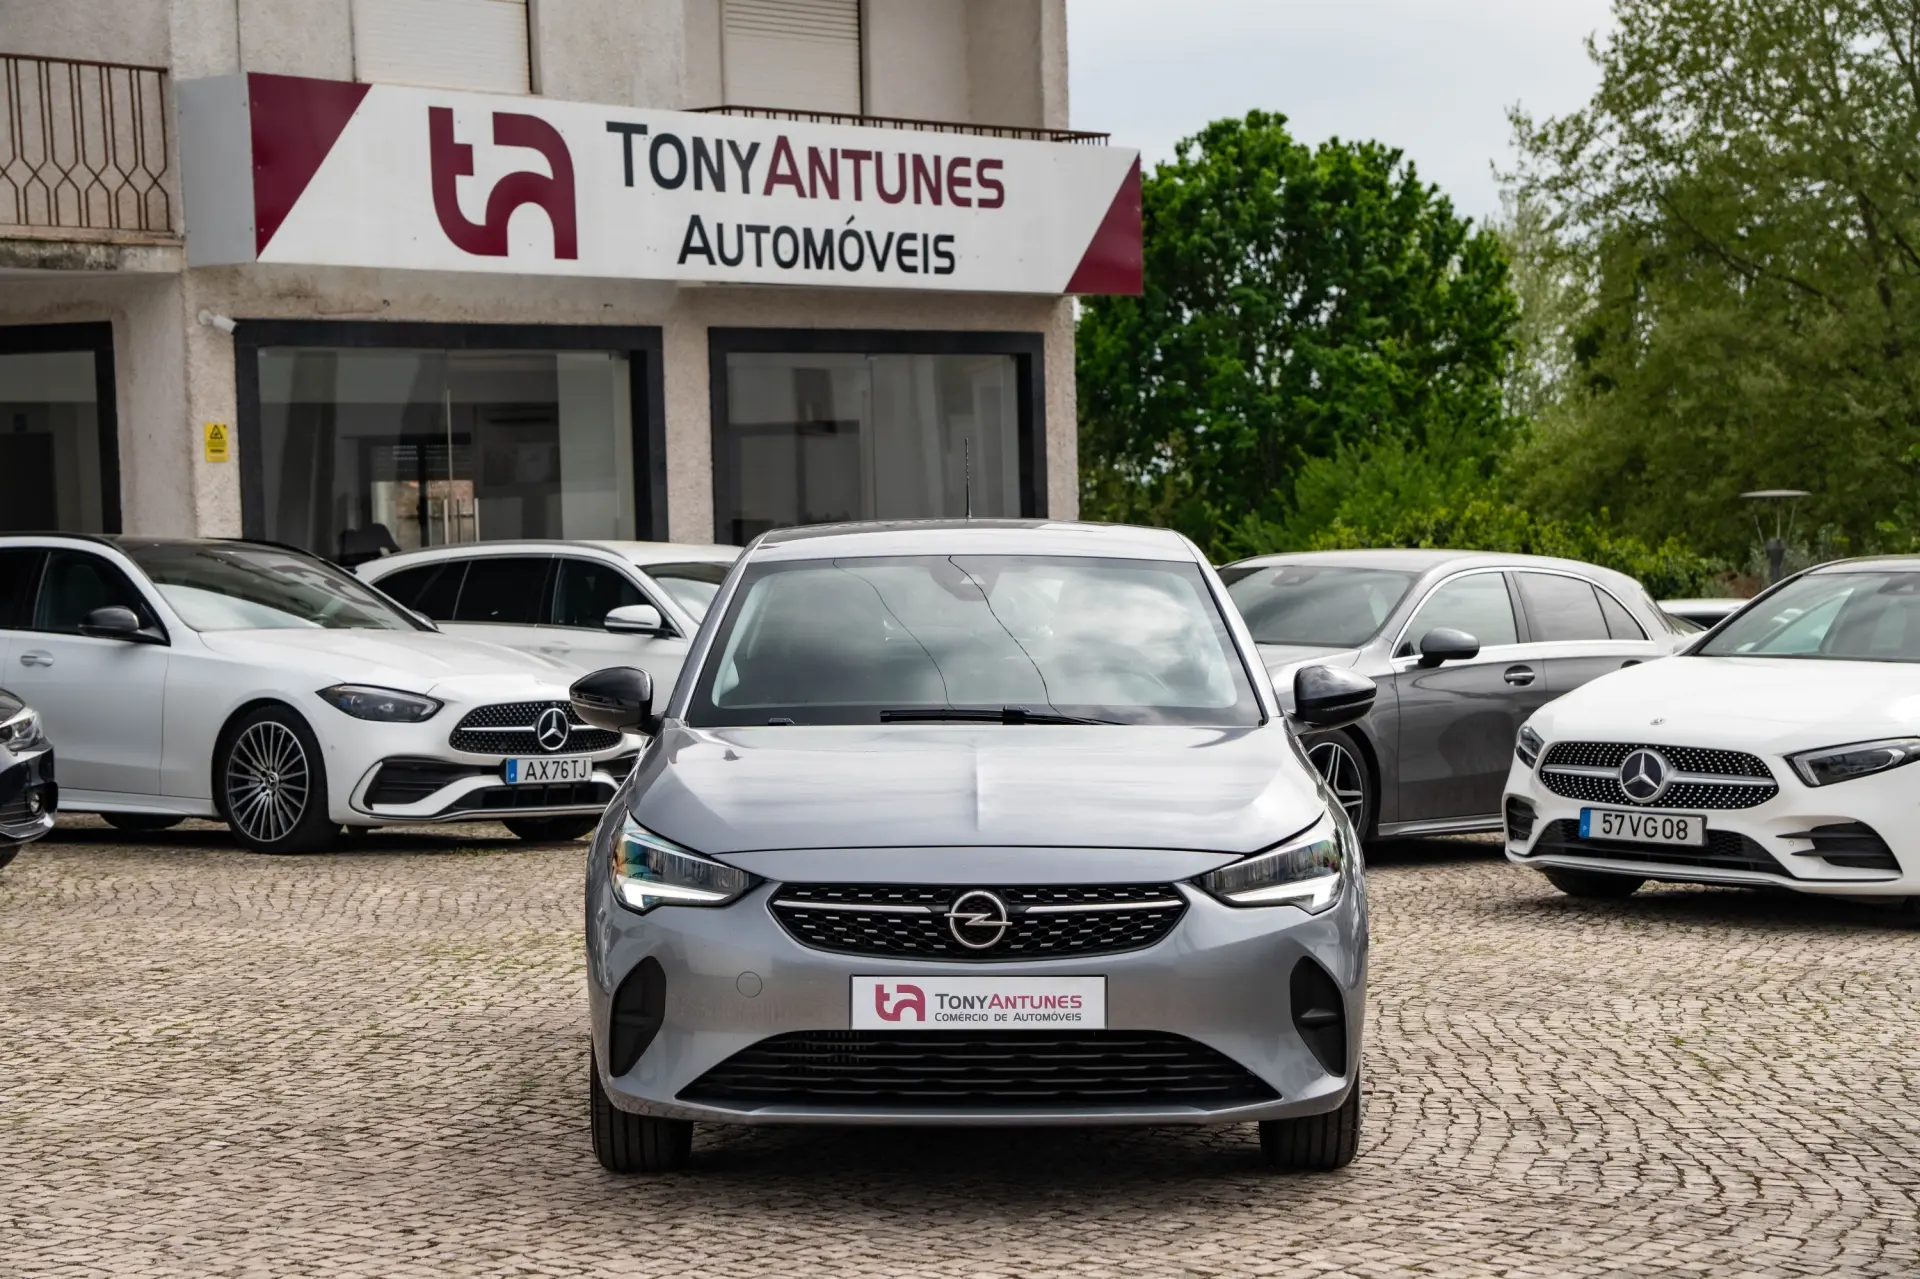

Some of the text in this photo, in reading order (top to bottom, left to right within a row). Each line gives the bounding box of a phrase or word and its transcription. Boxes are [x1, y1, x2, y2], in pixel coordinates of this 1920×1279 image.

[677, 214, 956, 276] AUTOMÓVEIS
[524, 759, 587, 781] AX76TJ
[1602, 812, 1689, 841] 57VG08
[934, 1011, 1082, 1022] COMÉRCIO DE AUTOMÓVEIS
